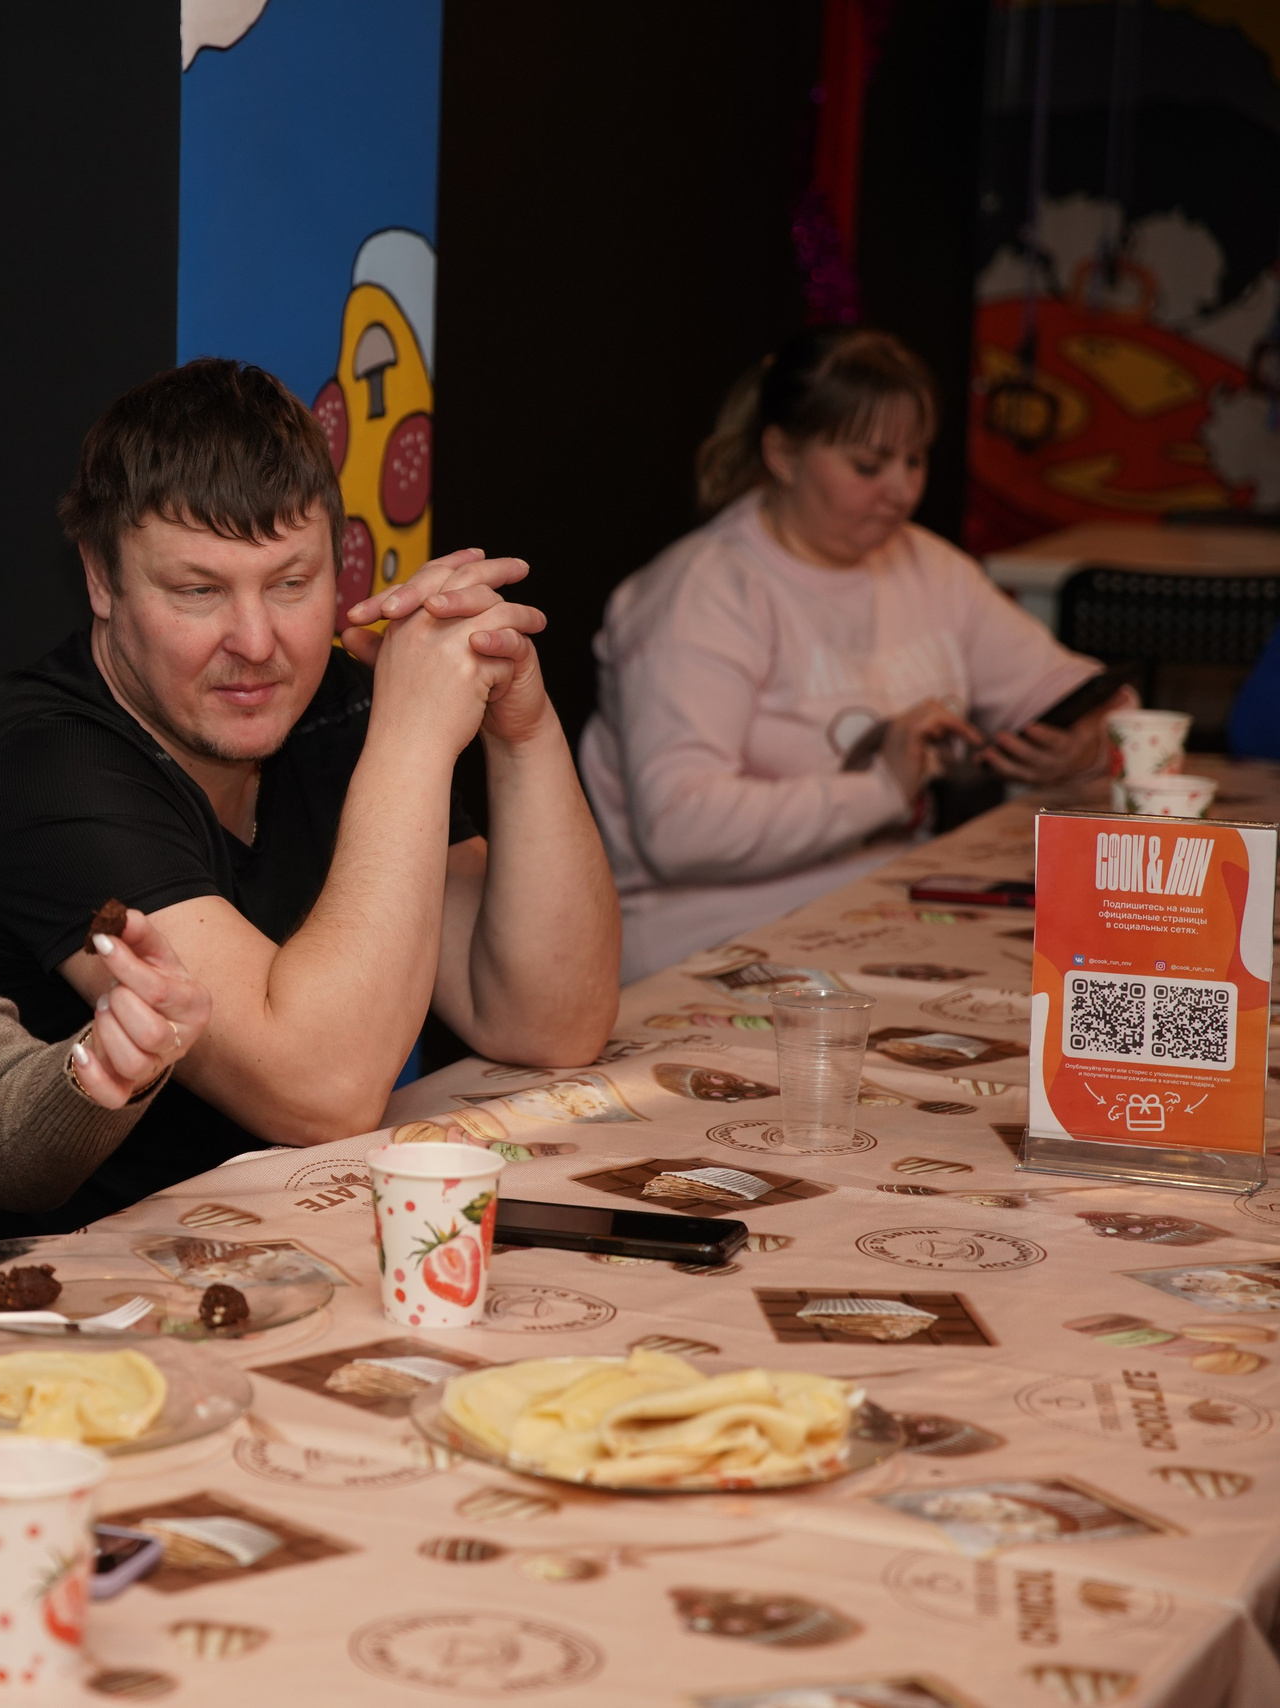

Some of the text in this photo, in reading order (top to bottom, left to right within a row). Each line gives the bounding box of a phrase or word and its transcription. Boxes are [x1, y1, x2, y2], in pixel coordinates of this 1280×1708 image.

[1095, 832, 1215, 897] COOK & RUN
[1103, 899, 1164, 912] Подпишитесь
[1179, 906, 1204, 914] наши
[1098, 910, 1208, 926] официальные страницы
[1113, 923, 1168, 933] социальных
[1170, 926, 1199, 935] сетях.
[1065, 1063, 1101, 1071] Опубликуйте
[1154, 1071, 1193, 1079] упоминанием
[1110, 1074, 1157, 1083] вознаграждение
